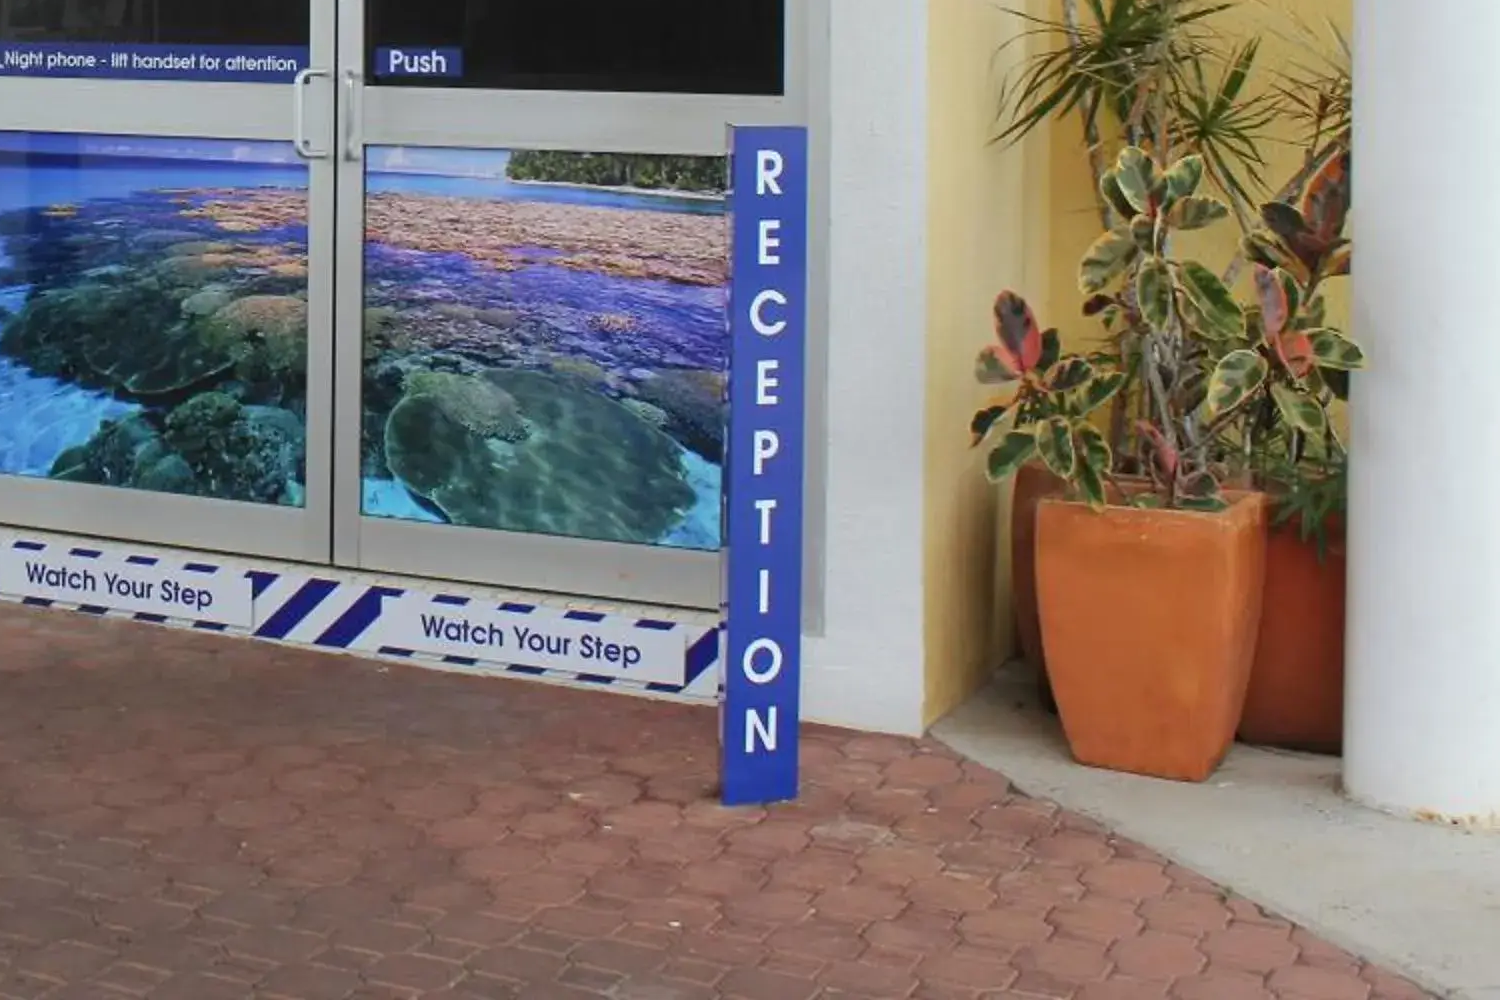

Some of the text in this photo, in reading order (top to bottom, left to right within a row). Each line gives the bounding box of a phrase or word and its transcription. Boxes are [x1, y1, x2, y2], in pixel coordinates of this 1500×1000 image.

[4, 50, 43, 69] Night
[47, 51, 97, 70] phone
[111, 52, 129, 69] lift
[132, 52, 197, 70] handset
[200, 54, 221, 70] for
[225, 55, 298, 72] attention
[389, 49, 447, 73] Push
[741, 149, 788, 754] RECEPTION
[25, 561, 214, 611] Watch Your Step
[420, 614, 642, 669] Watch Your Step
